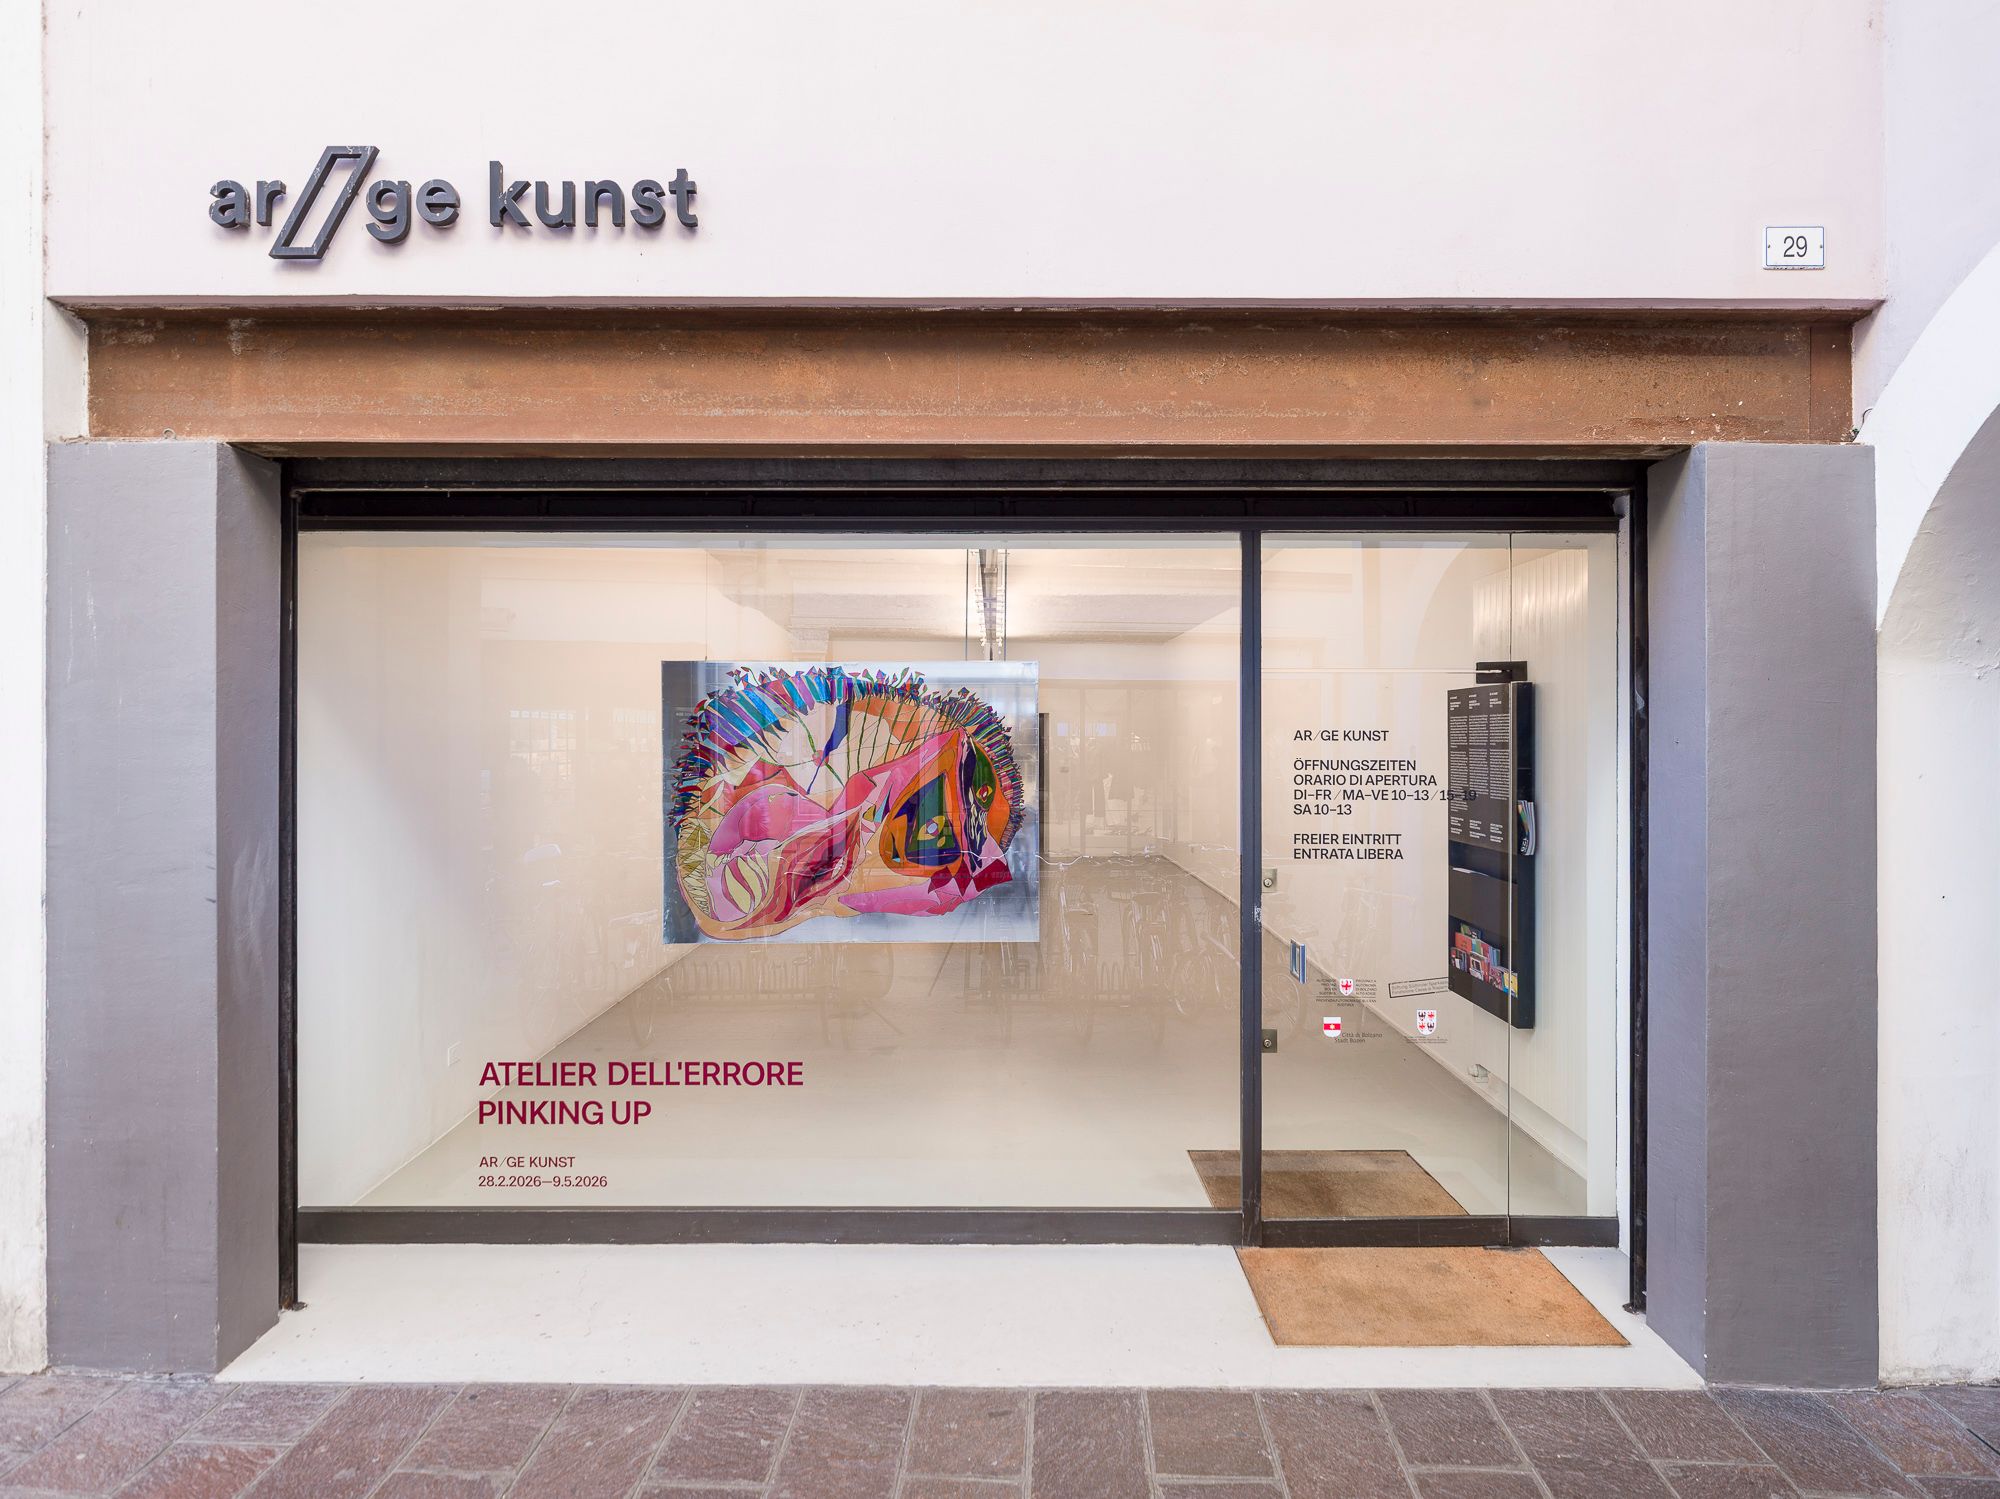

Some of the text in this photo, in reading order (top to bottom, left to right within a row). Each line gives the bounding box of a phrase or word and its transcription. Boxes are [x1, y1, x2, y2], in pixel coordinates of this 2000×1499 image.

[489, 160, 698, 229] kunst
[1783, 235, 1808, 258] 29
[1343, 729, 1390, 742] KUNST
[1293, 757, 1417, 771] ÖFFNUNGSZEITEN
[1293, 774, 1438, 787] ORARIO DI APERTURA
[1293, 803, 1312, 816] SA
[1293, 833, 1403, 845] FREIER EINTRITT
[1293, 848, 1404, 860] ENTRATA LIBERA
[478, 1061, 804, 1087] ATELIER DELL'ERRORE
[478, 1100, 652, 1126] PINKING UP
[529, 1156, 576, 1169] KUNST
